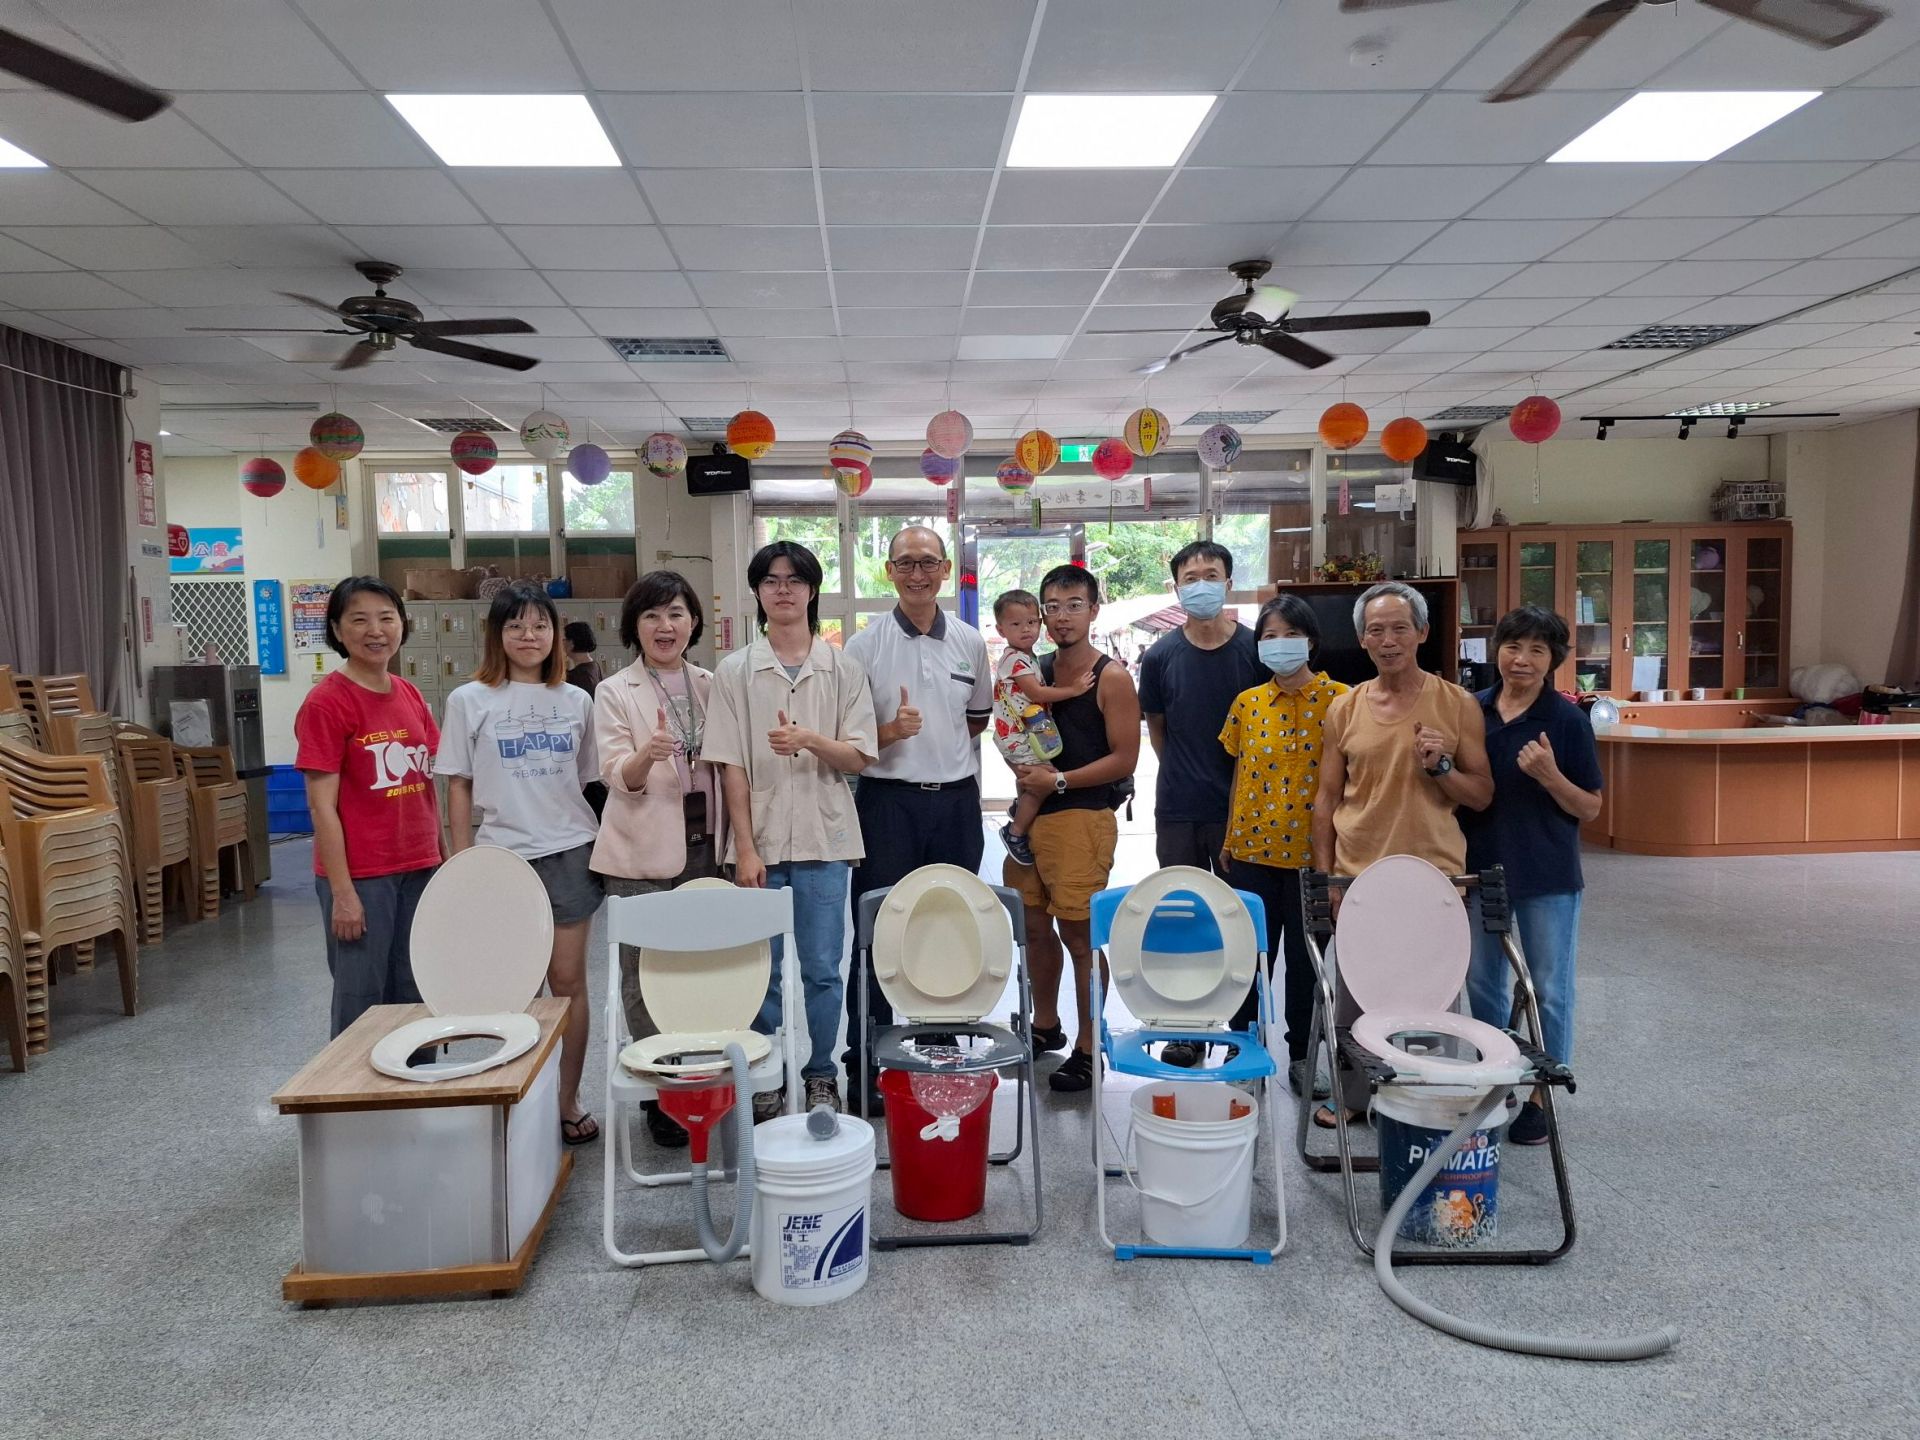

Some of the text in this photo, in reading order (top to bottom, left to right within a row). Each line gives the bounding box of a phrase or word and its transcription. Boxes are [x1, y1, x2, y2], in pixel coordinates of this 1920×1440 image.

[355, 728, 409, 744] YES WE
[502, 734, 572, 757] HAPPY
[512, 767, 564, 778] 今日の楽しみ
[1408, 1142, 1500, 1171] PMATES
[783, 1214, 823, 1230] JENE
